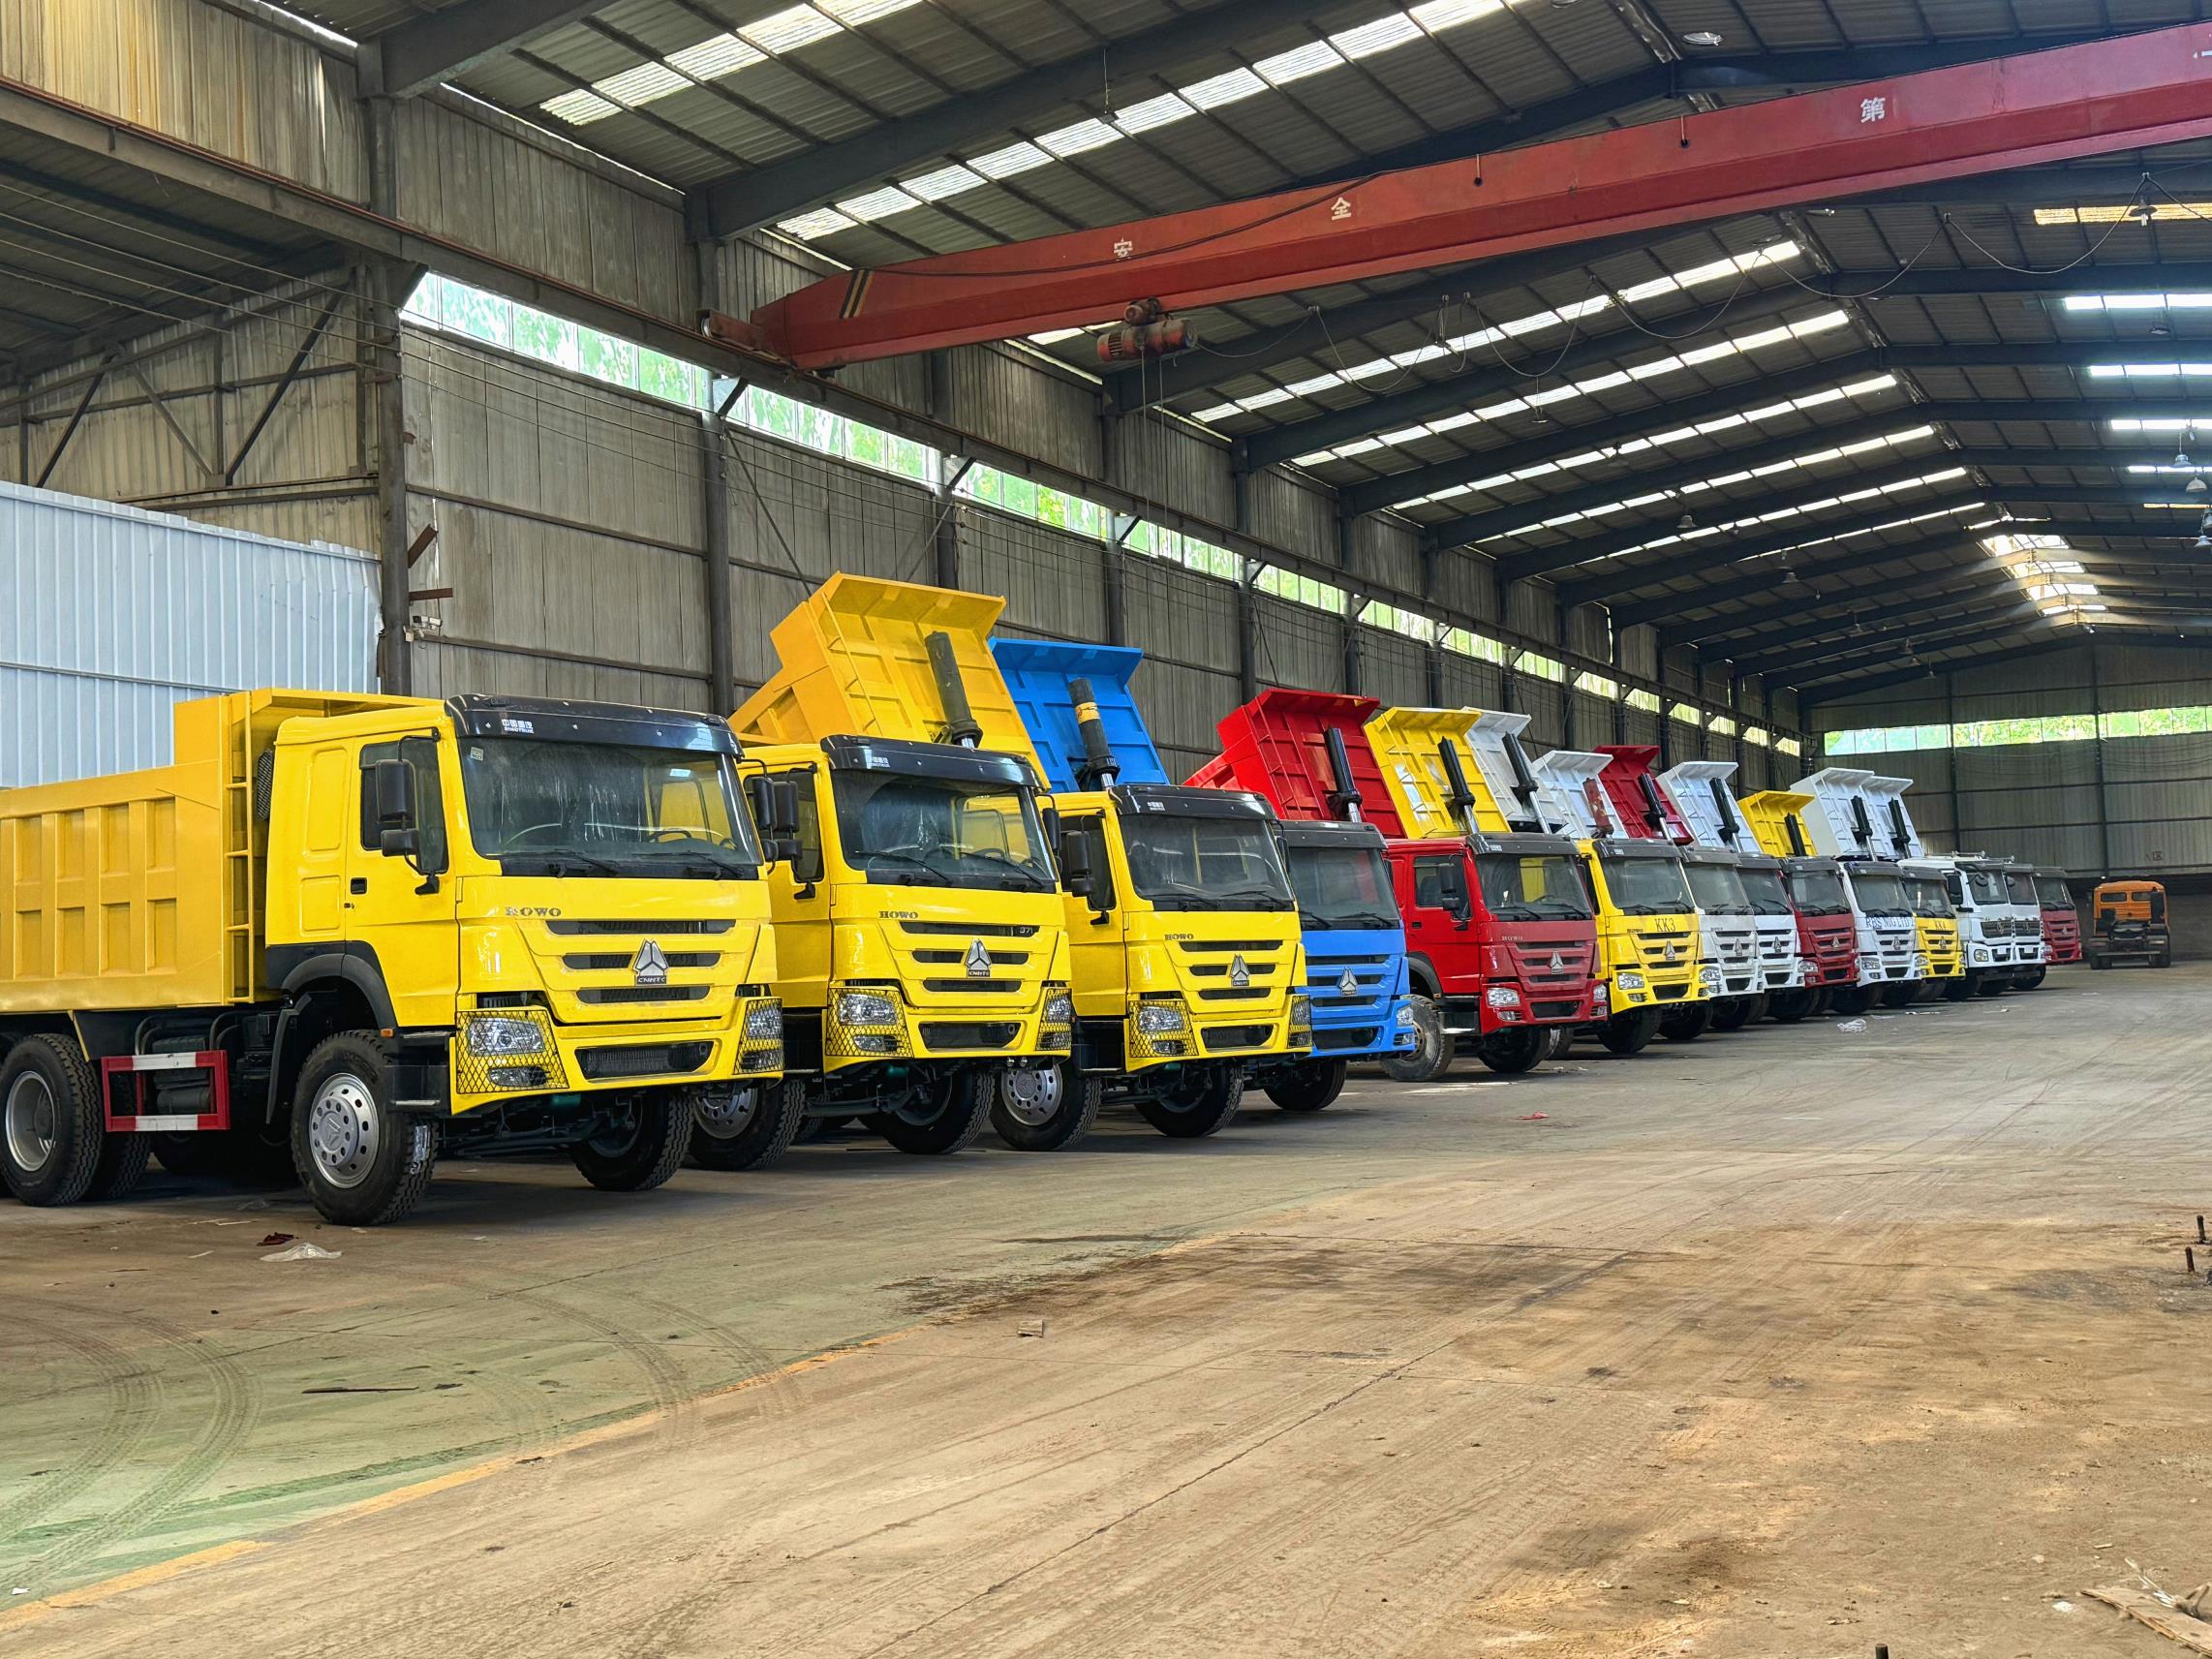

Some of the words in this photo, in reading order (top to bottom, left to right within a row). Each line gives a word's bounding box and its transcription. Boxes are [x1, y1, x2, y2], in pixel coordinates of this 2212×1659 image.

[1331, 197, 1352, 221] 全
[1860, 97, 1886, 123] 第
[878, 910, 919, 919] HOWO
[1654, 918, 1675, 932] KK3
